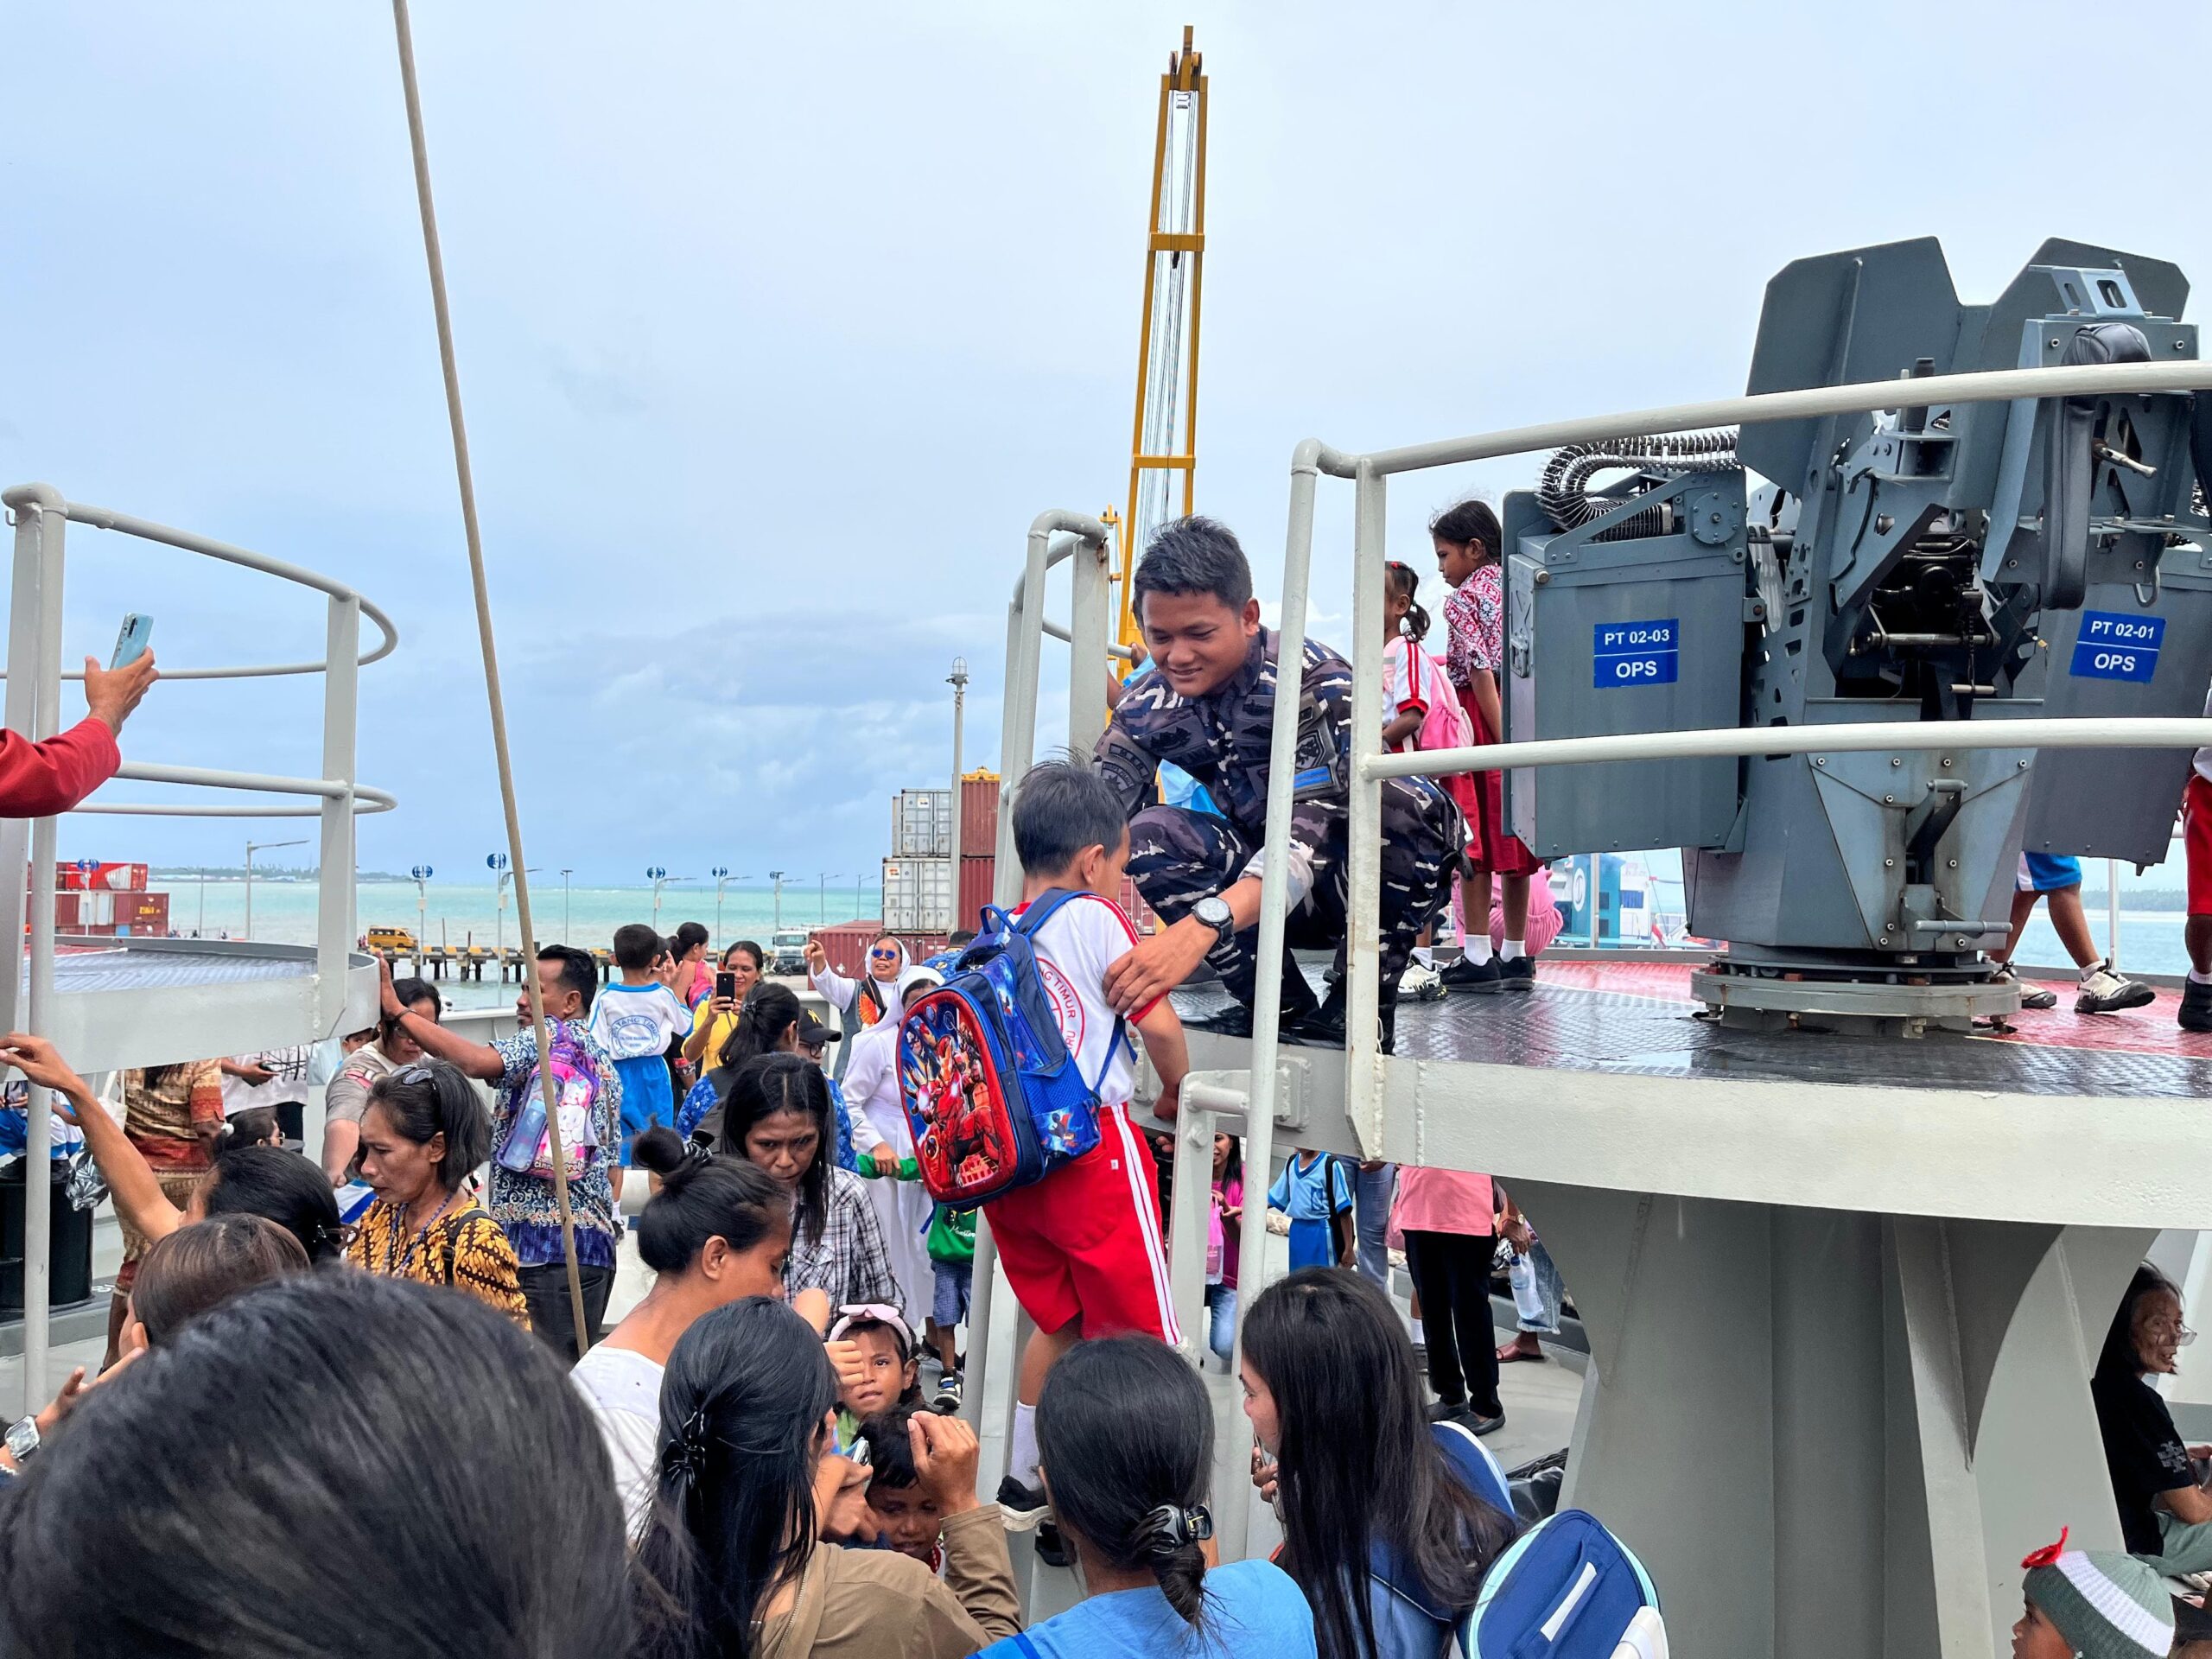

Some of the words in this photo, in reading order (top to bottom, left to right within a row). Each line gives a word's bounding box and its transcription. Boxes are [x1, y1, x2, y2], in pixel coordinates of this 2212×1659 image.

[1605, 632, 1625, 645] PT
[1629, 629, 1670, 644] 02-03
[2090, 620, 2113, 635] PT
[2115, 623, 2155, 639] 02-01
[1616, 660, 1657, 678] OPS
[2094, 653, 2136, 671] OPS
[1053, 977, 1077, 1019] TIMUR
